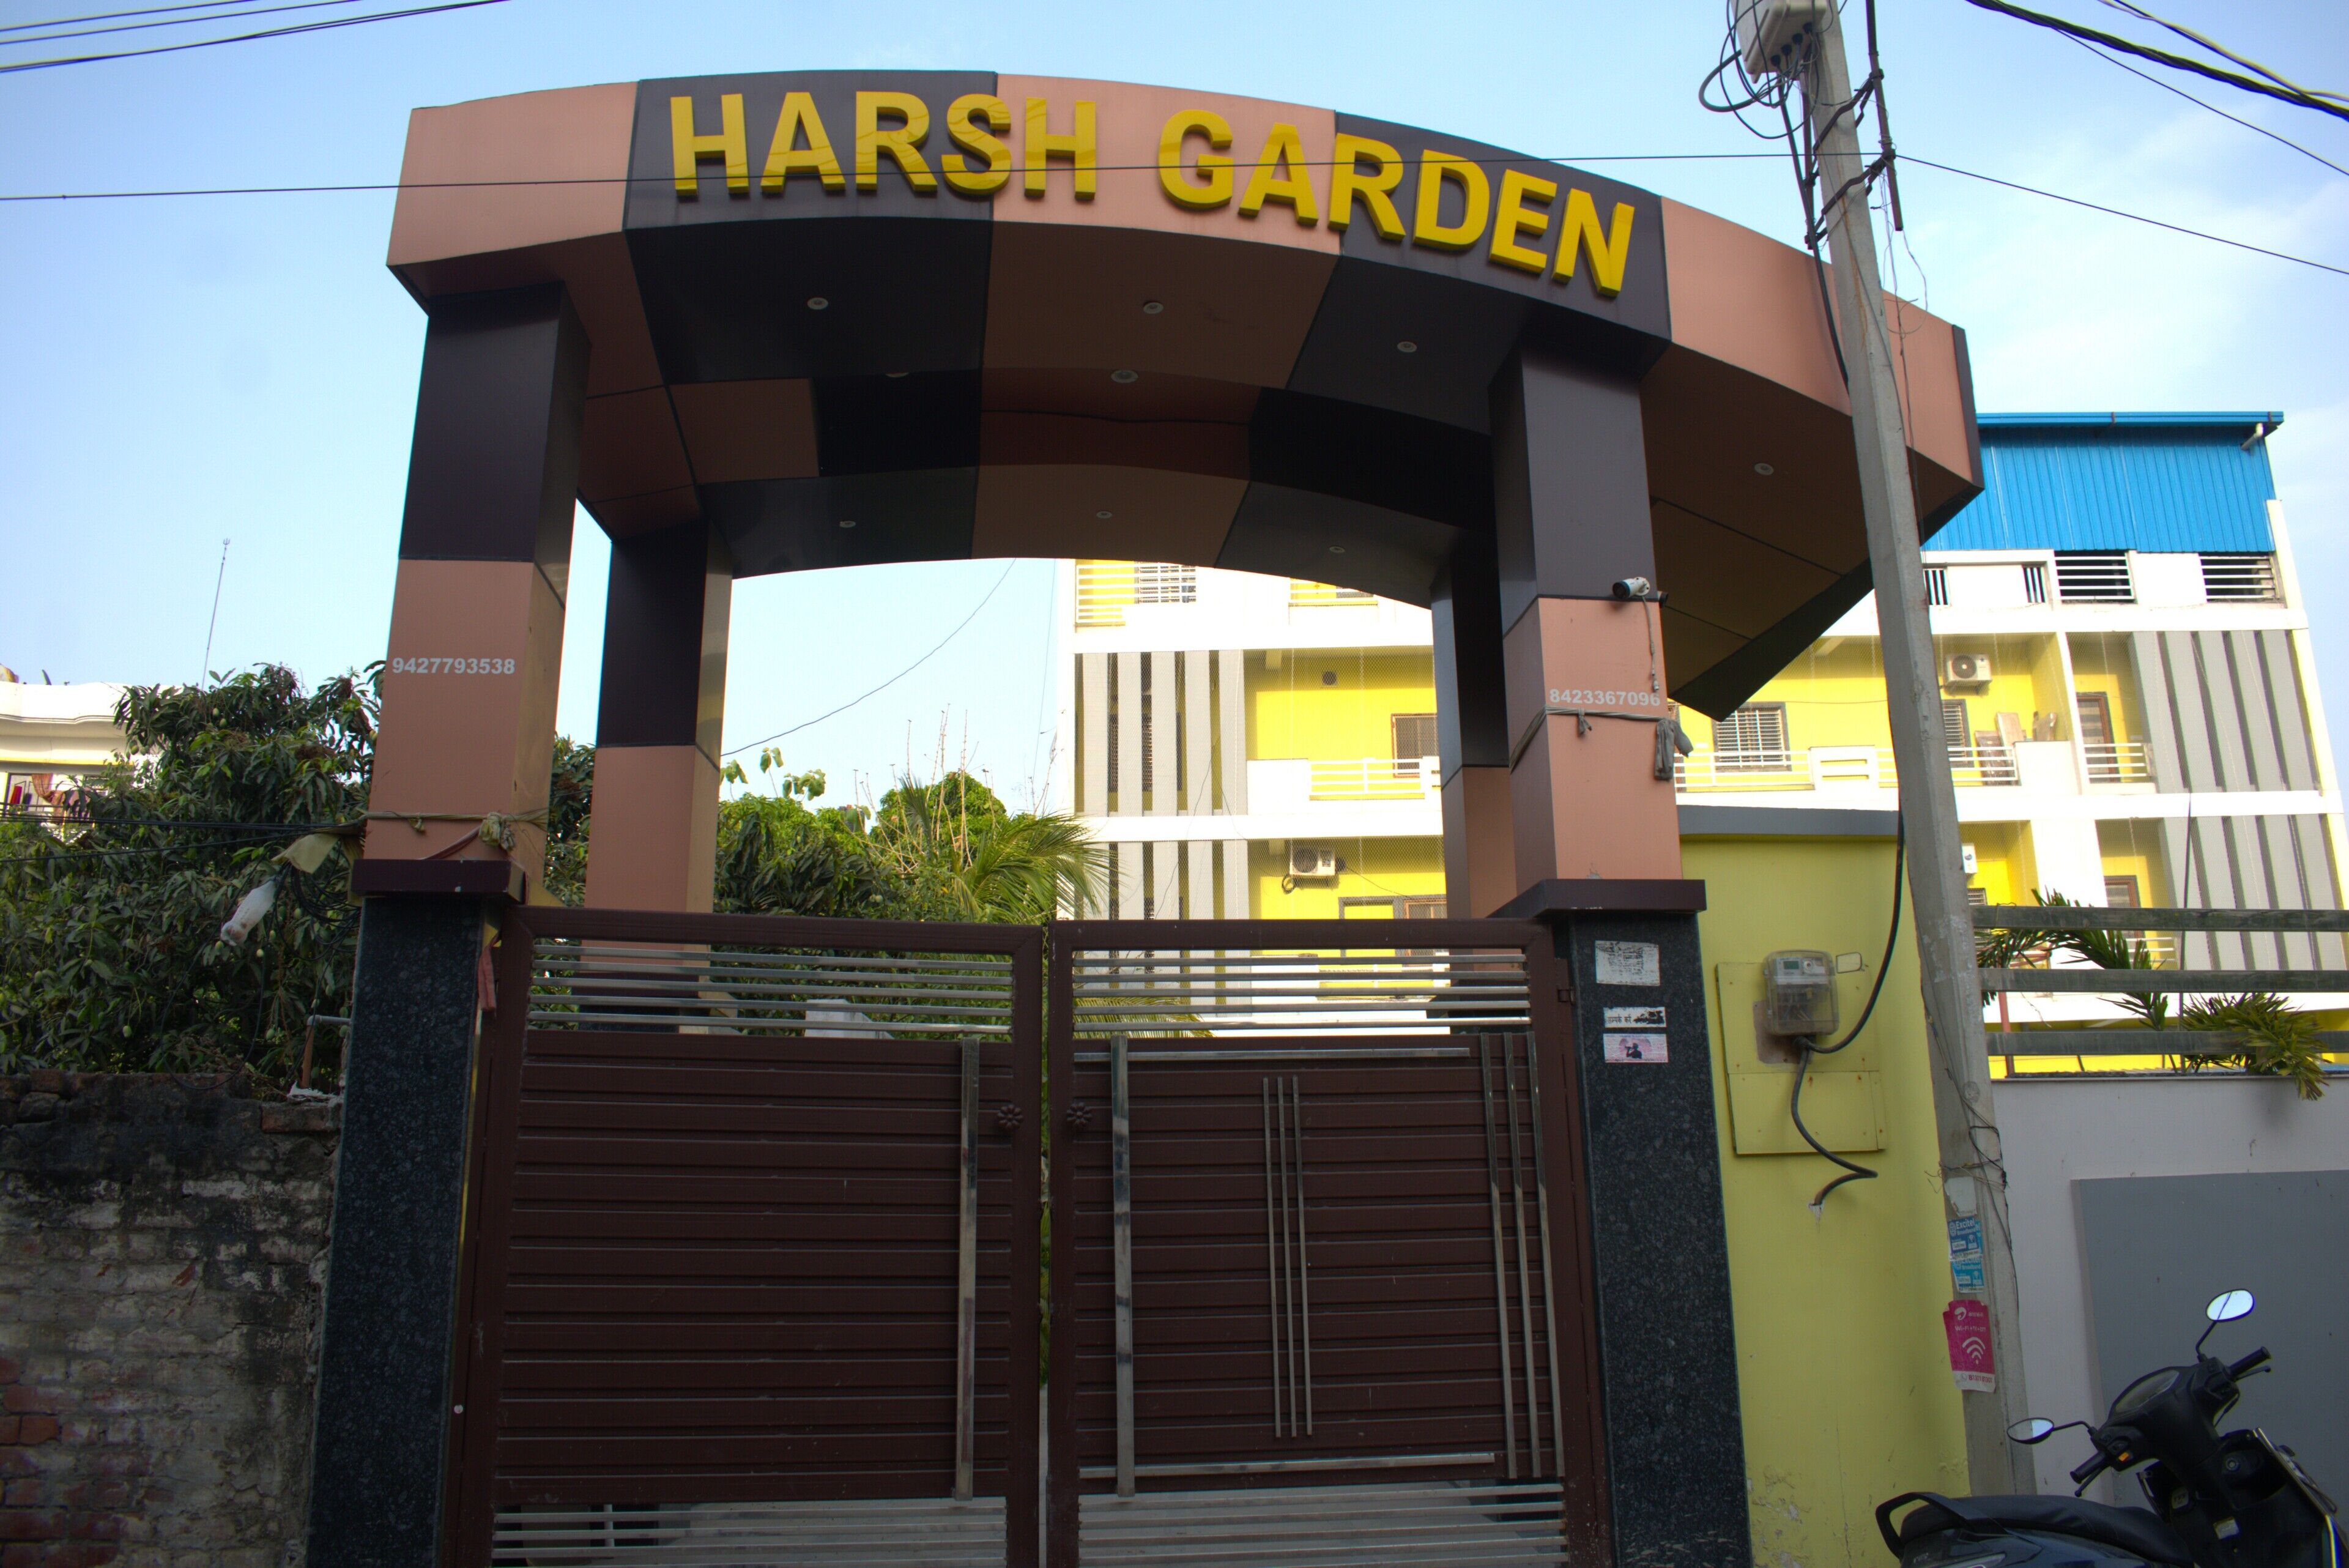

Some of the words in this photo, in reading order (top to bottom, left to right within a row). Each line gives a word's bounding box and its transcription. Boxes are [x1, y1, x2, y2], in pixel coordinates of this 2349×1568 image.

[670, 91, 1096, 200] HARSH
[1157, 109, 1635, 297] GARDEN
[392, 657, 516, 674] 9427793538
[1549, 689, 1661, 706] 8423367096
[1956, 1218, 1975, 1228] Excitel
